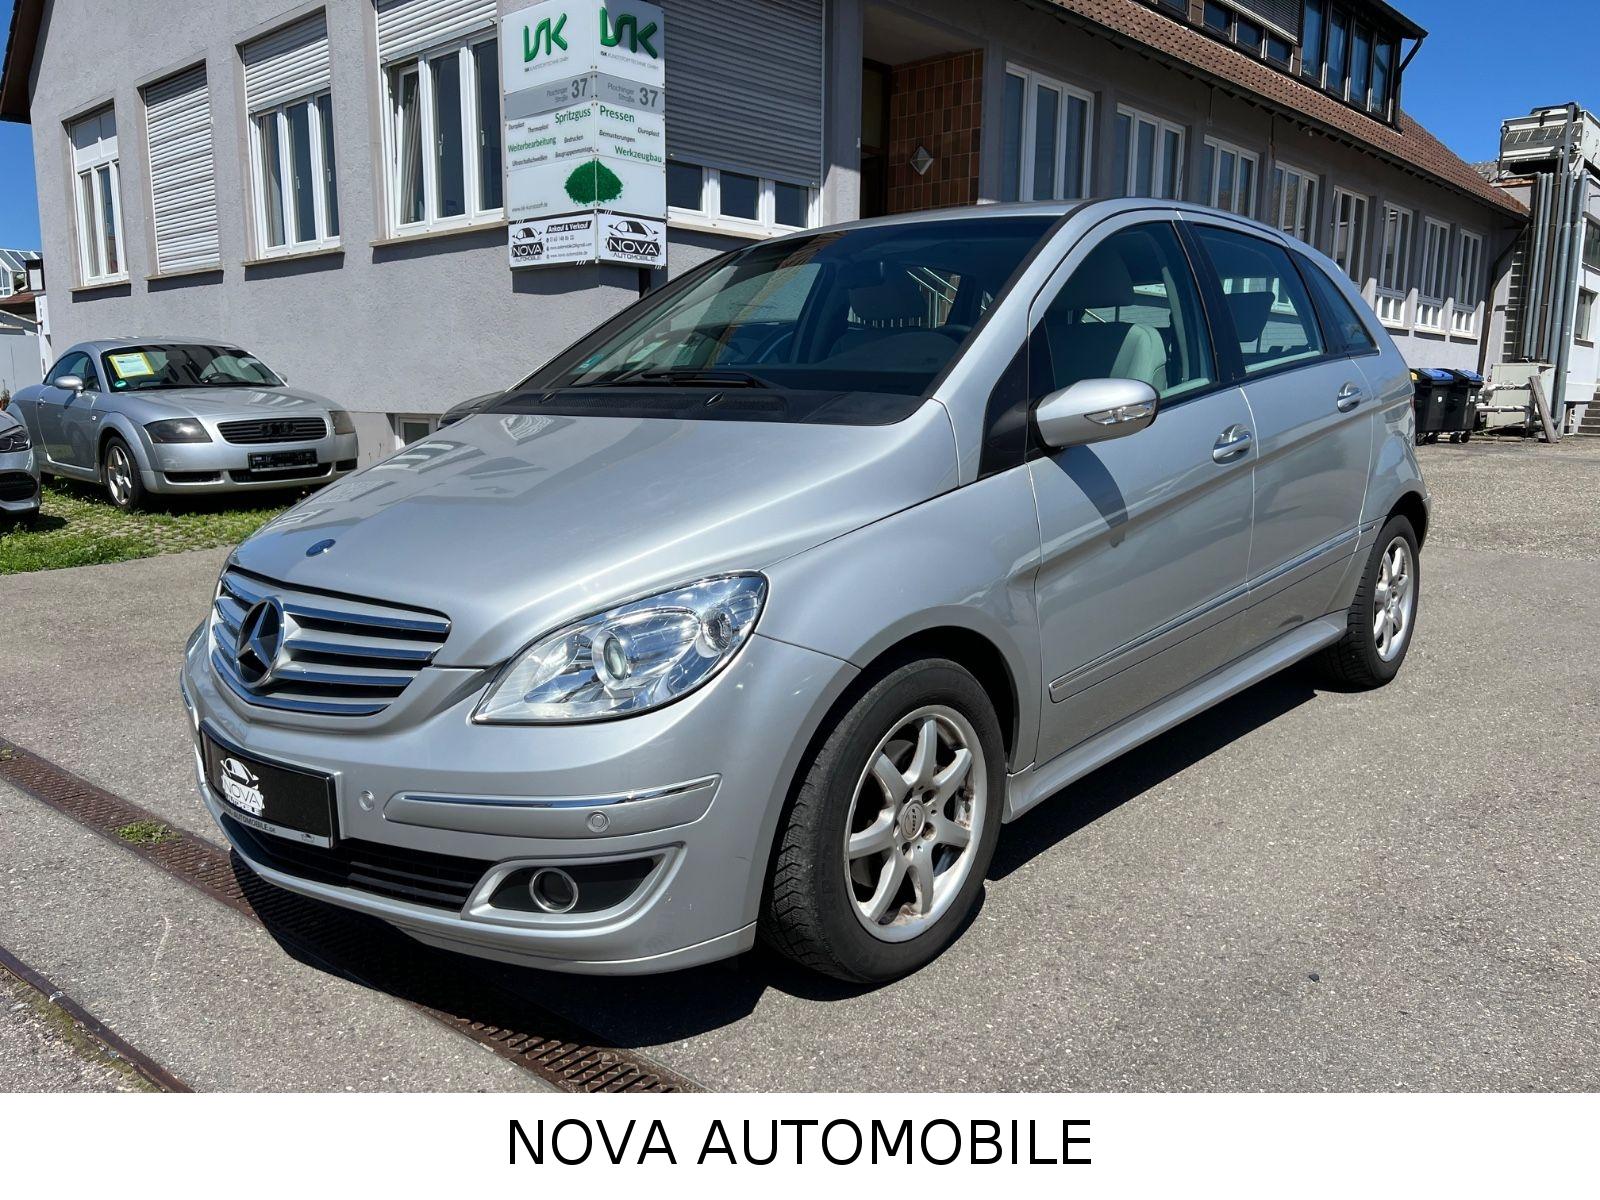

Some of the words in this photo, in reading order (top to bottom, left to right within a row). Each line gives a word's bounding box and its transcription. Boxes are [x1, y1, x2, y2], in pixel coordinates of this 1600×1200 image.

[571, 77, 588, 99] 37
[639, 86, 659, 108] 37
[555, 108, 591, 125] Spritzguss
[600, 105, 635, 122] Pressen
[507, 137, 557, 152] Weiterbearbeitung
[614, 145, 662, 162] Werkzeugbau
[548, 223, 566, 233] Ankauf
[569, 221, 589, 231] Verkauf
[512, 243, 542, 257] NOVA
[609, 238, 659, 256] NOVA
[613, 252, 656, 263] AUTOMOBILE
[223, 777, 261, 810] NOVA
